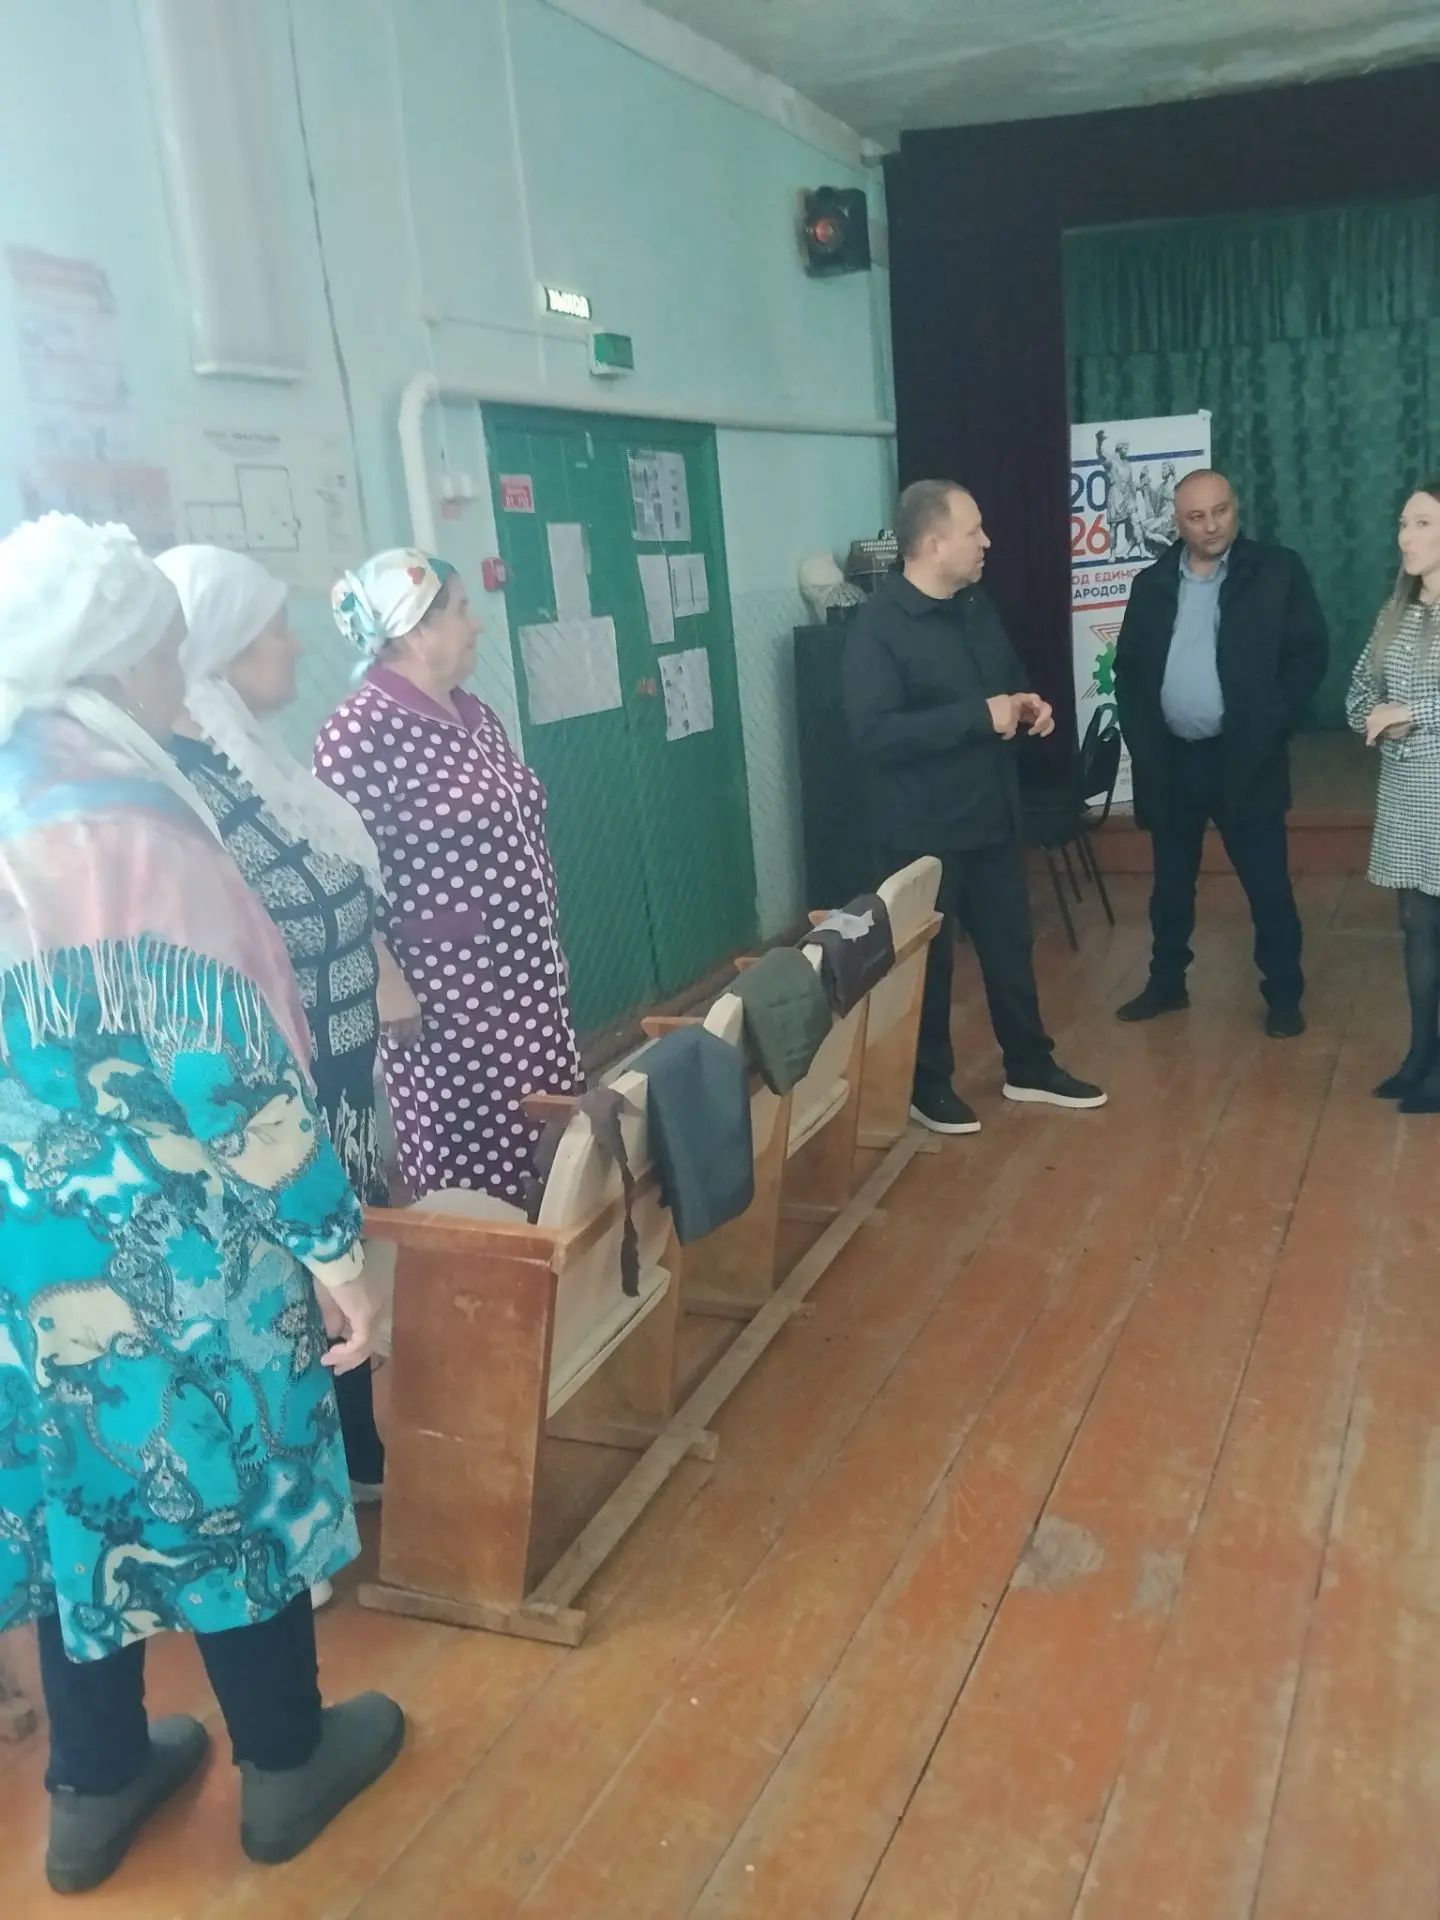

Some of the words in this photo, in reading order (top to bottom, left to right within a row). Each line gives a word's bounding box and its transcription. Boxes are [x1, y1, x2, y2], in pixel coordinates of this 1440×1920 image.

[1071, 470, 1109, 513] 20
[1071, 513, 1110, 556] 26
[1095, 568, 1143, 582] ЕДИНС
[1074, 584, 1127, 599] АРОДОВ
